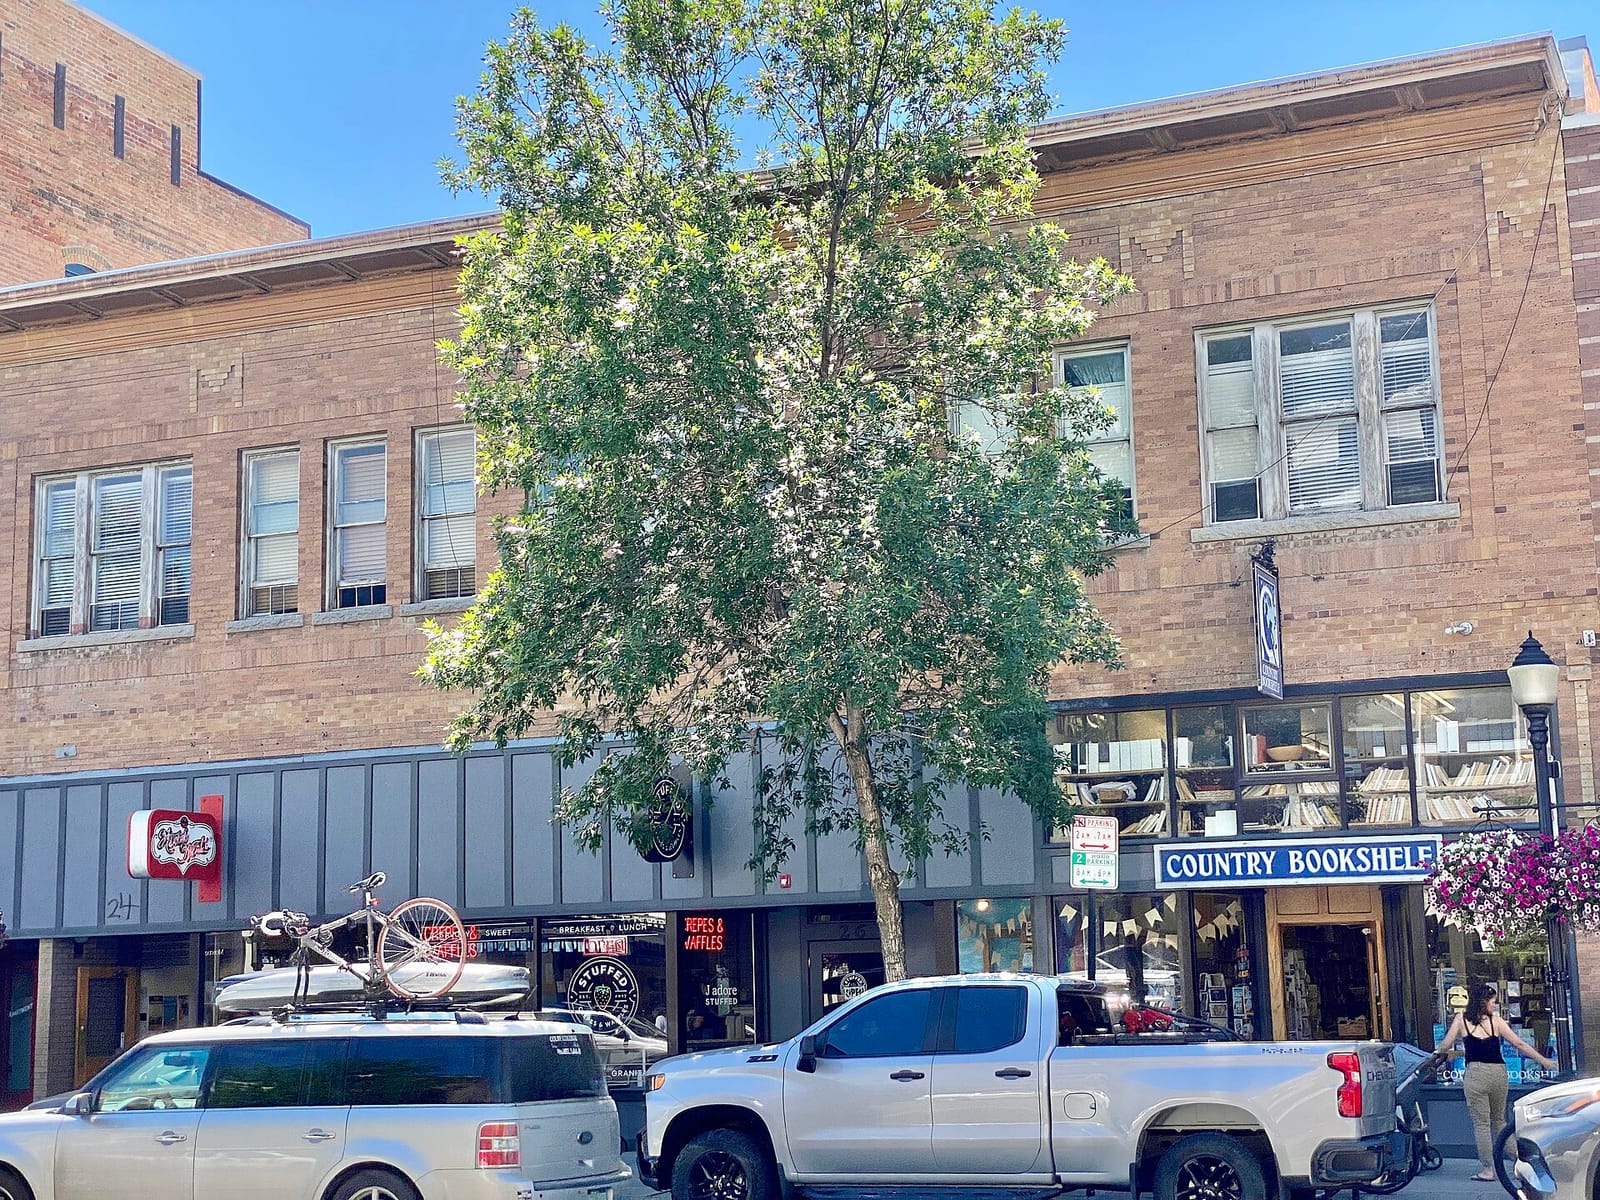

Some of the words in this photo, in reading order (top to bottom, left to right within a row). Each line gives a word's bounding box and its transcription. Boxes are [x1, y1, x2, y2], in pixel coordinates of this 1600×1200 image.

[1087, 819, 1114, 828] PARKING
[1076, 853, 1083, 864] 2
[1166, 850, 1275, 878] COUNTRY
[1288, 845, 1433, 874] BOOKSHELF
[107, 893, 140, 920] 24
[559, 925, 606, 934] BREAKFAST
[618, 924, 647, 932] LUNCH
[684, 917, 715, 933] REPES
[716, 917, 724, 933] &
[485, 929, 512, 937] SWEET
[578, 964, 628, 988] STUFFED
[705, 998, 738, 1006] STUFFED
